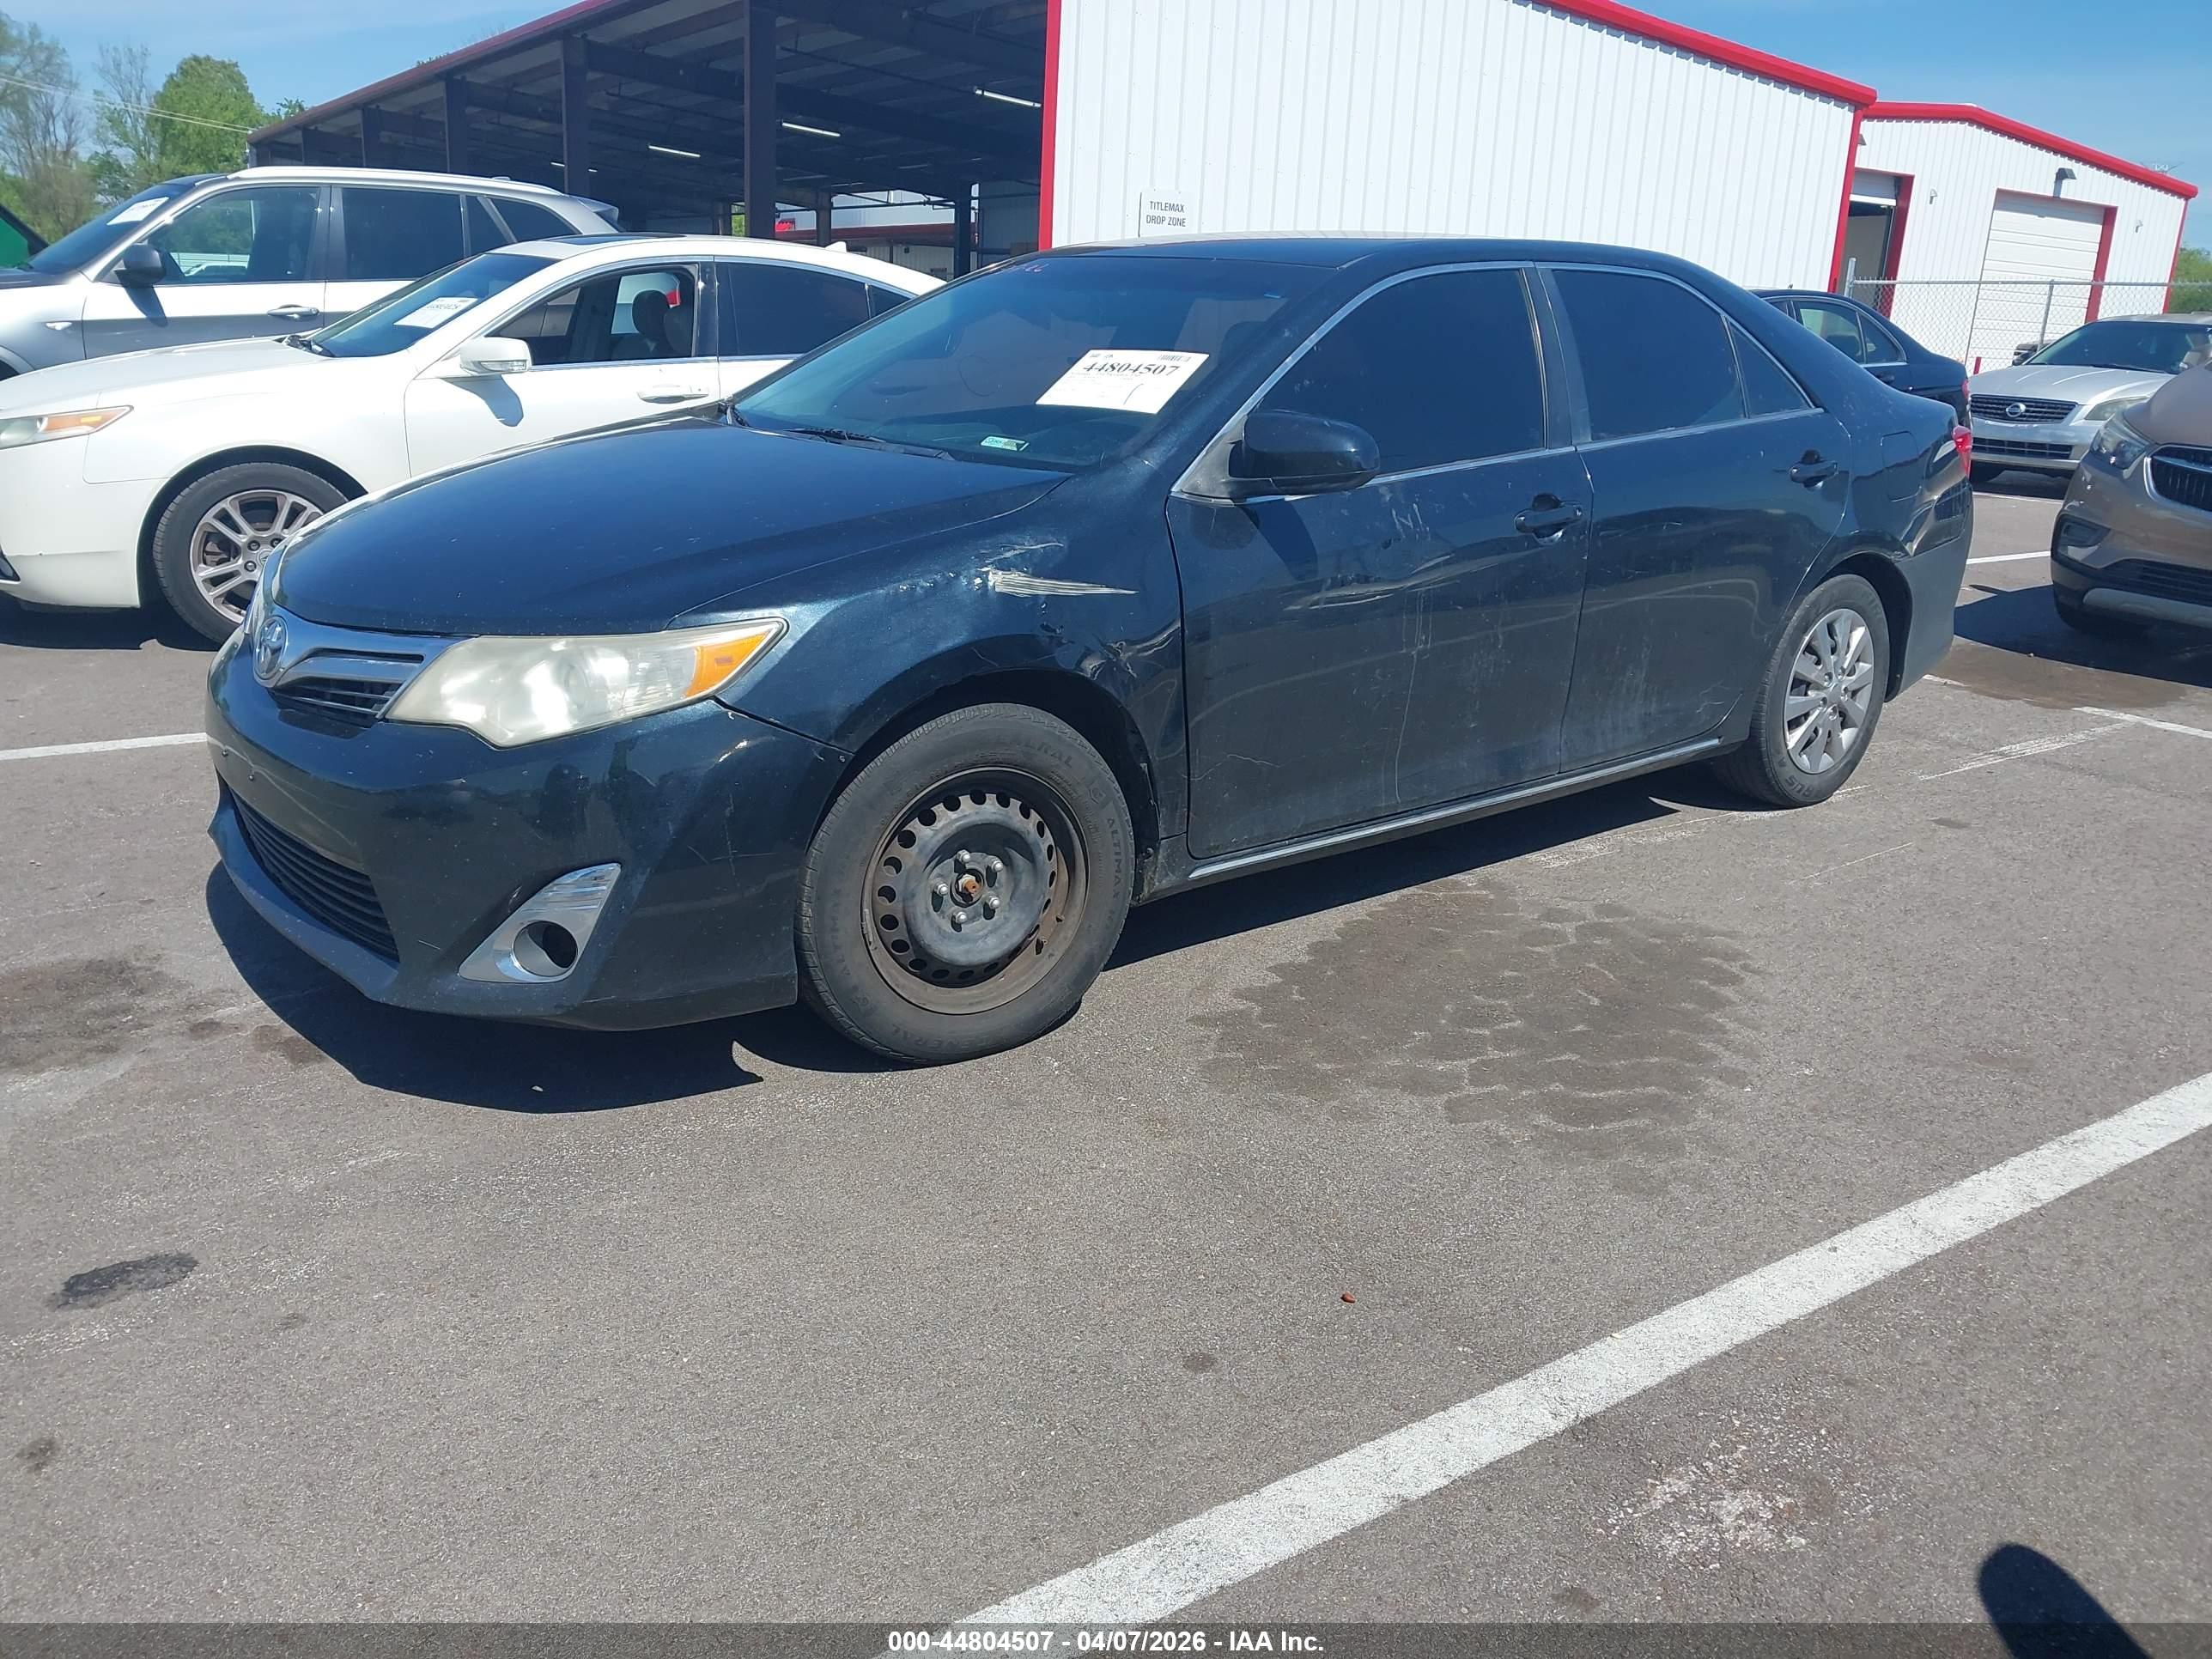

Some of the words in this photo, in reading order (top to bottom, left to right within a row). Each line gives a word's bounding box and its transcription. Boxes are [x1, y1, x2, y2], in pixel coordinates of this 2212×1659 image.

[1149, 200, 1185, 213] TITLEMAX
[1146, 214, 1166, 225] DROP
[1167, 216, 1187, 228] ZONE
[1083, 362, 1182, 376] 44804507
